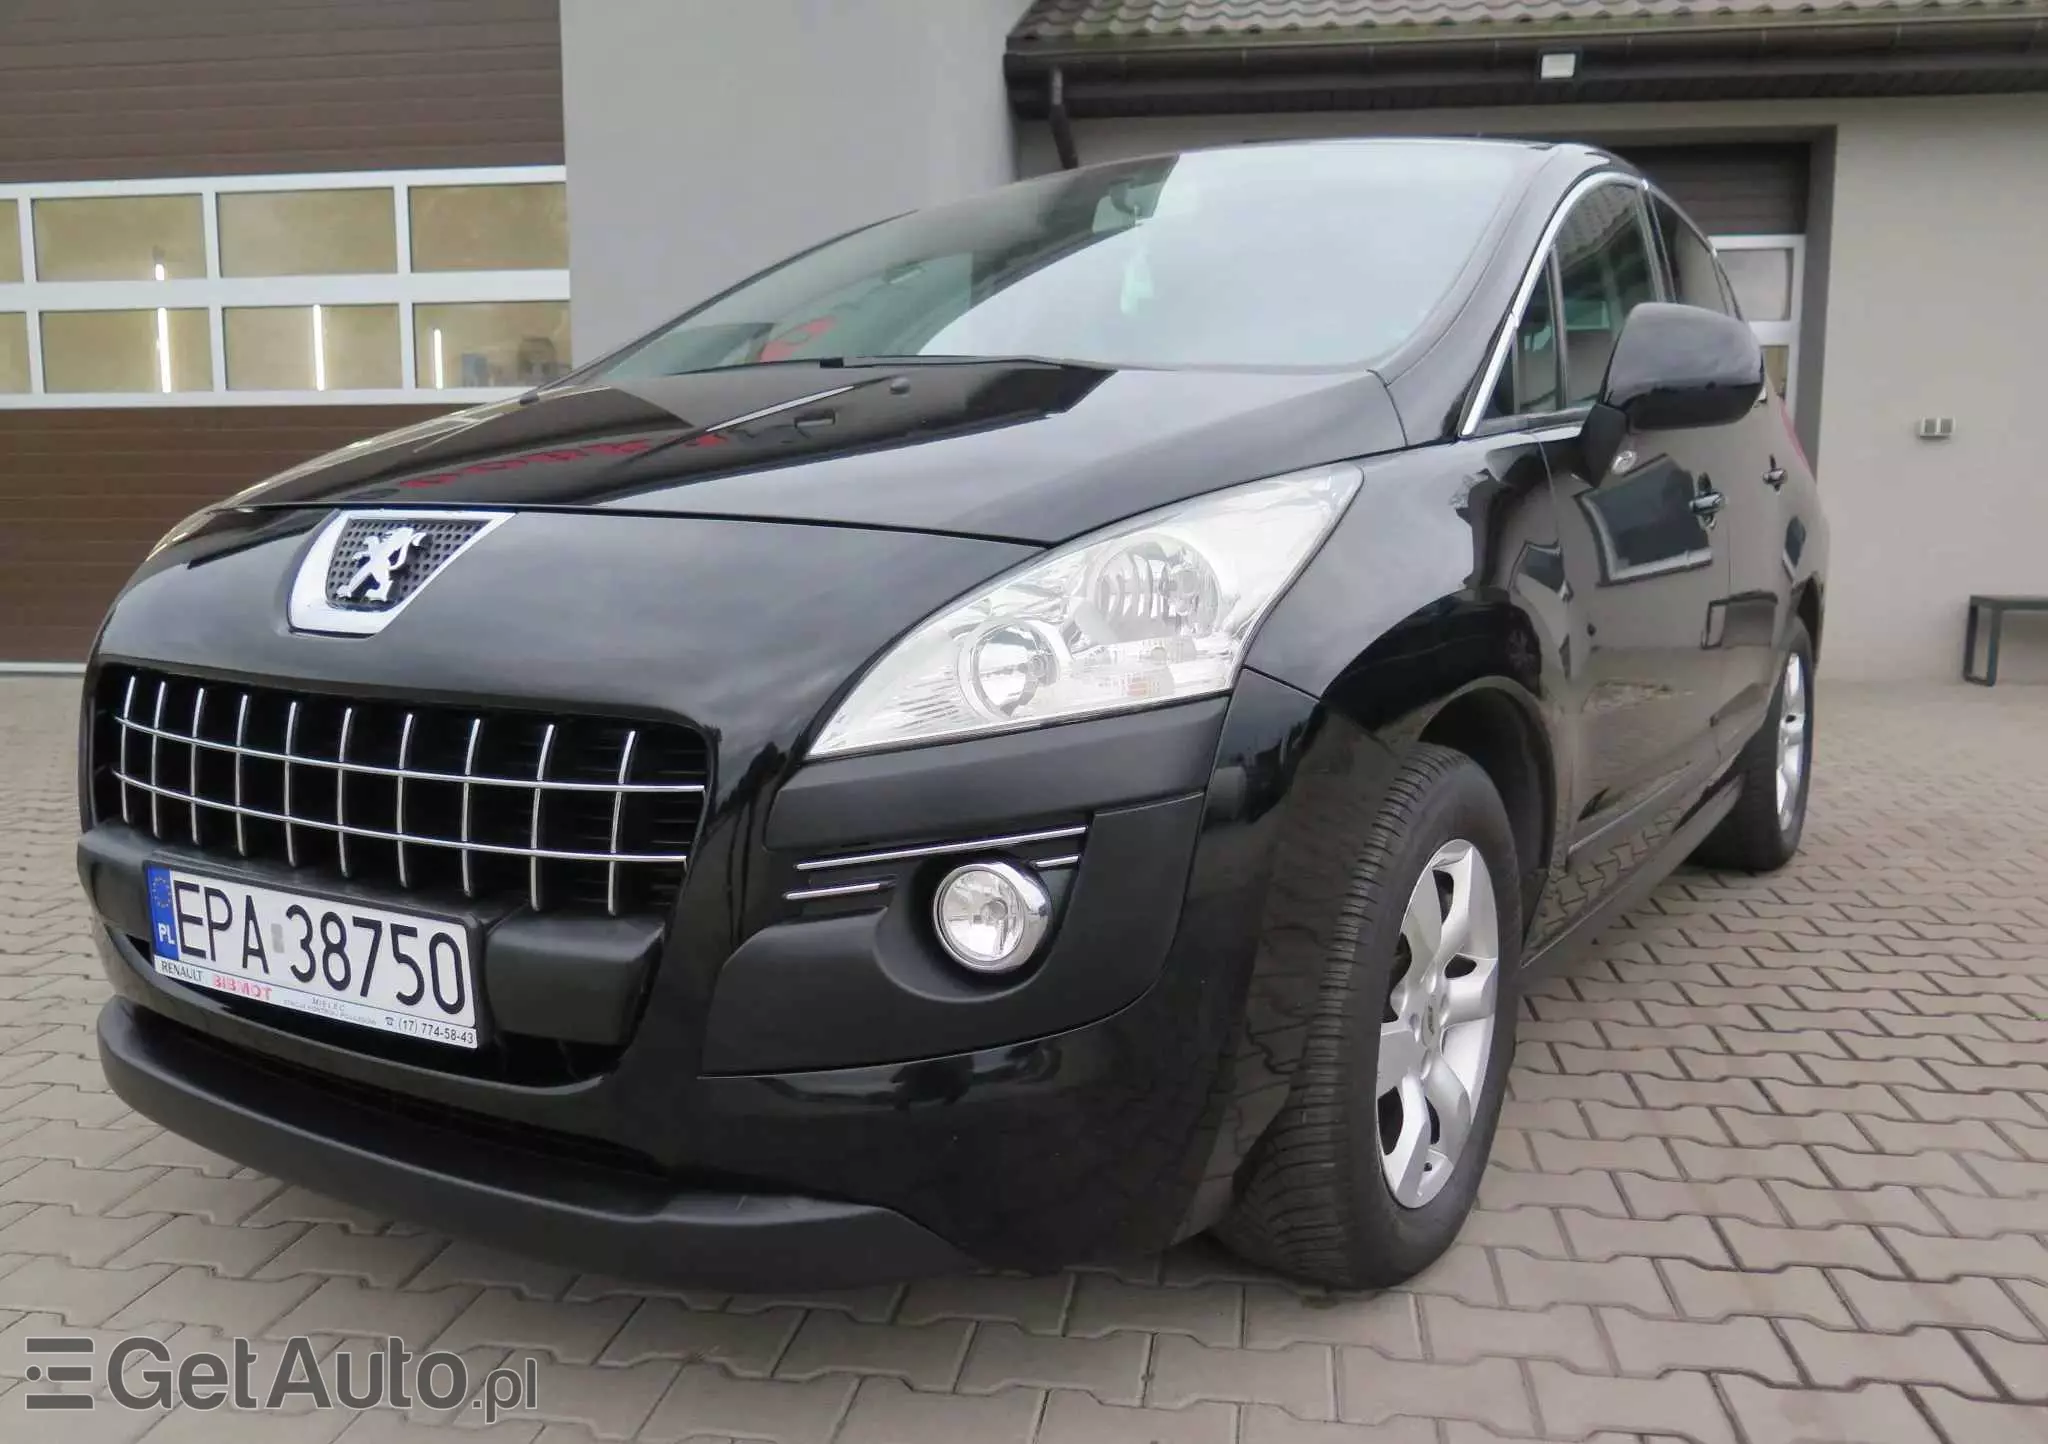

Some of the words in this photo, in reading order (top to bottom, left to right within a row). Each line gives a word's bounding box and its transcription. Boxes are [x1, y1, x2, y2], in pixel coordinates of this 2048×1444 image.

[158, 922, 175, 945] PL
[173, 879, 270, 975] EPA
[286, 904, 466, 1015] 38750
[161, 960, 204, 982] RENAULT
[398, 1018, 418, 1034] (17)
[421, 1022, 474, 1044] 774-58-43
